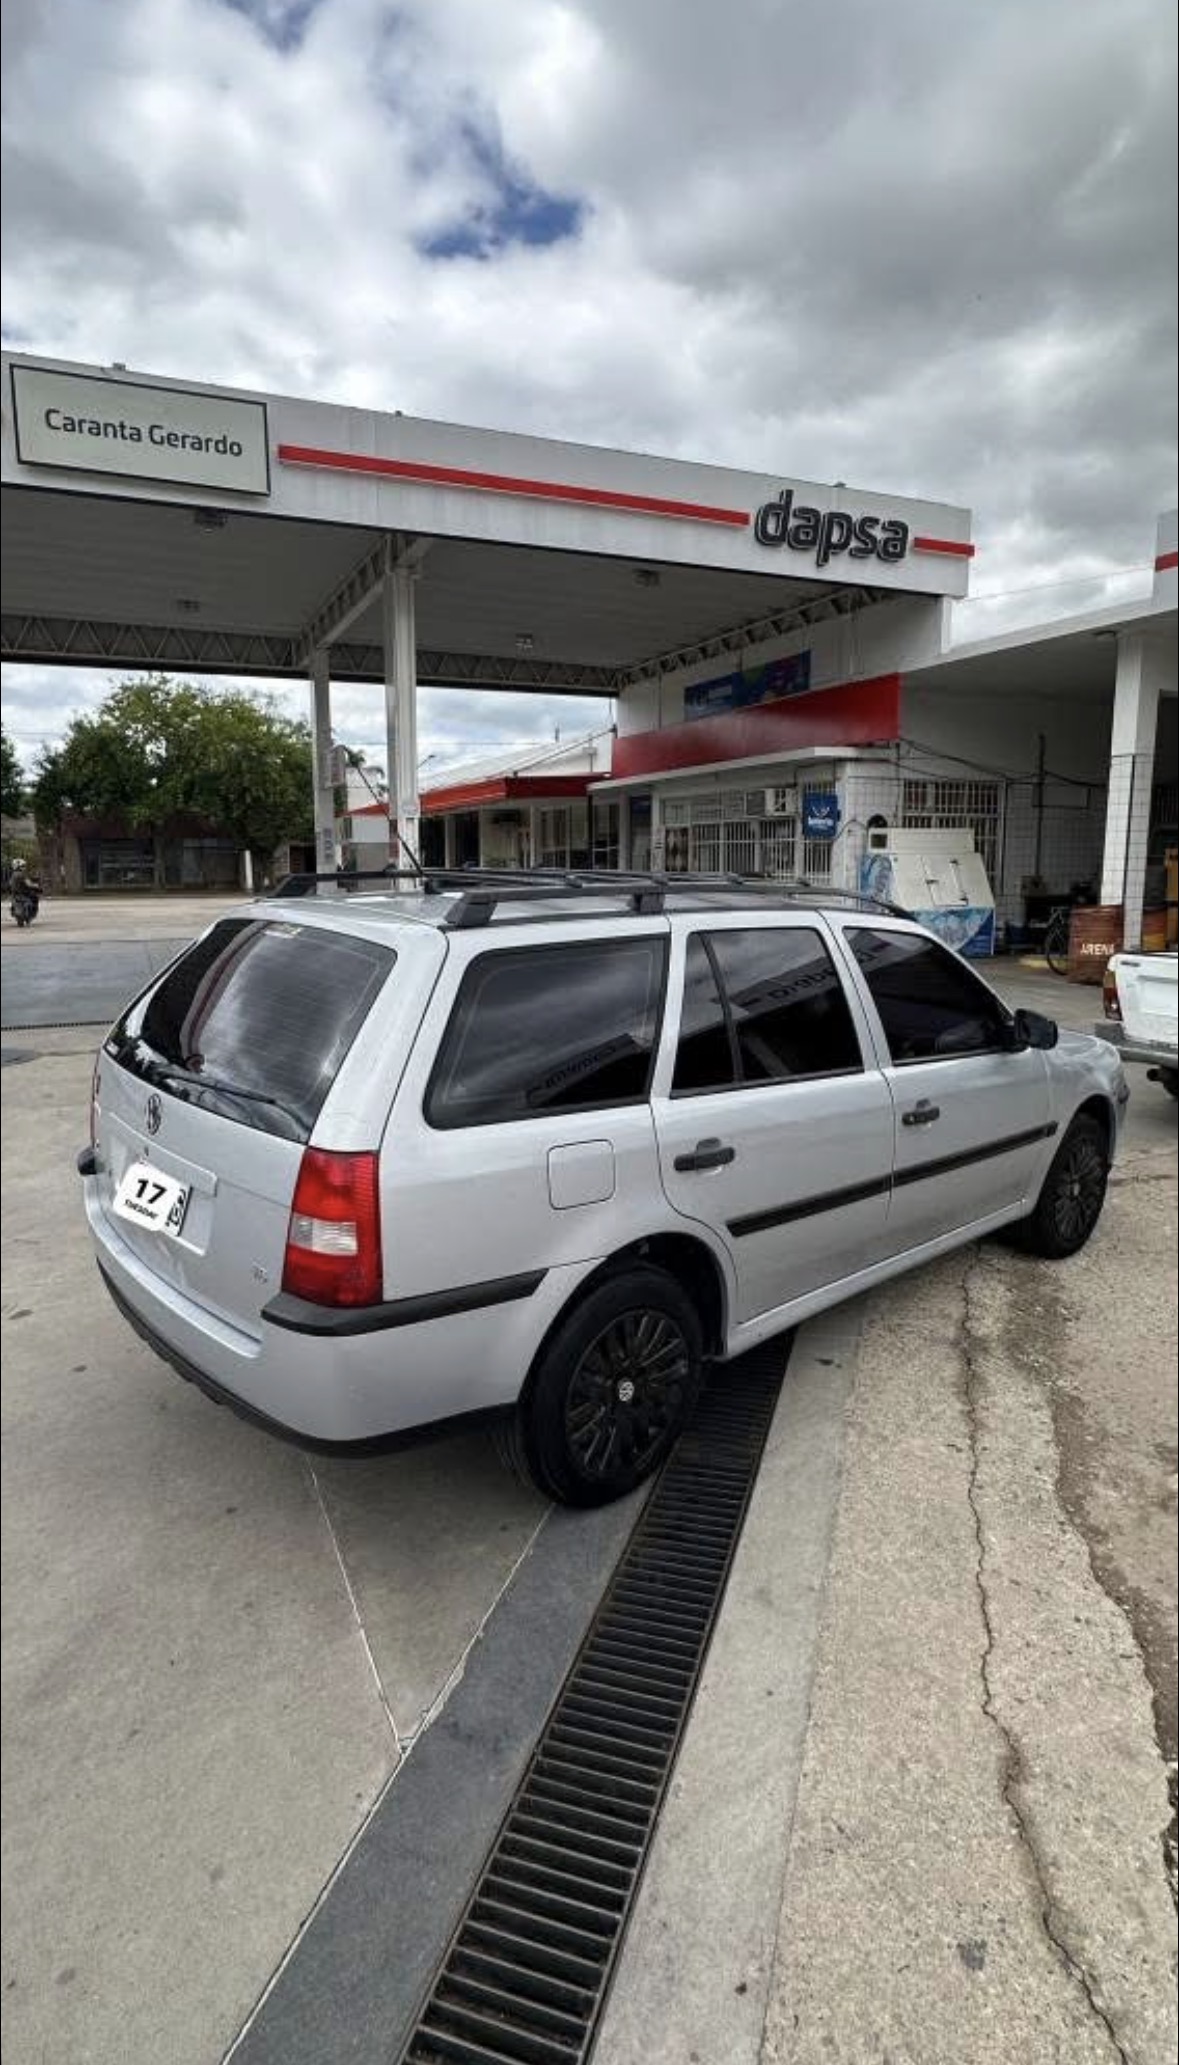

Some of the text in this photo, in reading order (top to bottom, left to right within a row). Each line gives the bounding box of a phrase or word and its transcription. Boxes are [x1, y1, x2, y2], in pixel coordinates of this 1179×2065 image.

[45, 408, 243, 457] Caranta Gerardo
[754, 489, 909, 567] dapsa
